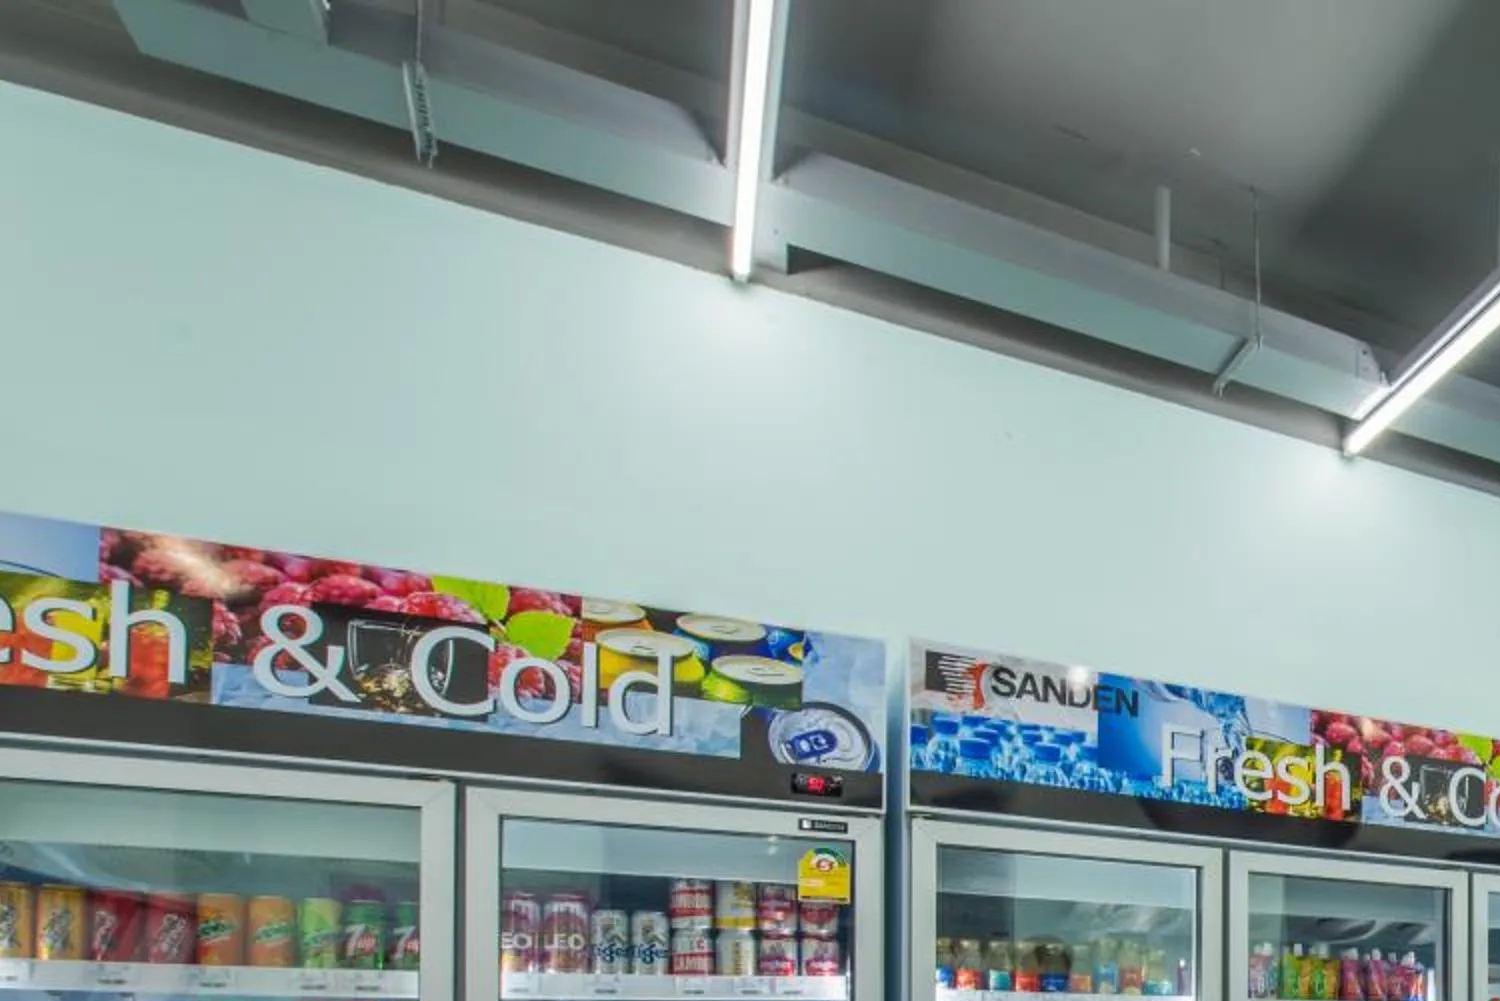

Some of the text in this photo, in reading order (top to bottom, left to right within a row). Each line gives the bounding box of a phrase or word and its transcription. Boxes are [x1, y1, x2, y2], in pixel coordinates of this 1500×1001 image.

[0, 579, 675, 737] sh & Cold
[989, 667, 1140, 718] SANDEN
[1160, 722, 1352, 811] Fresh
[1380, 756, 1431, 821] &
